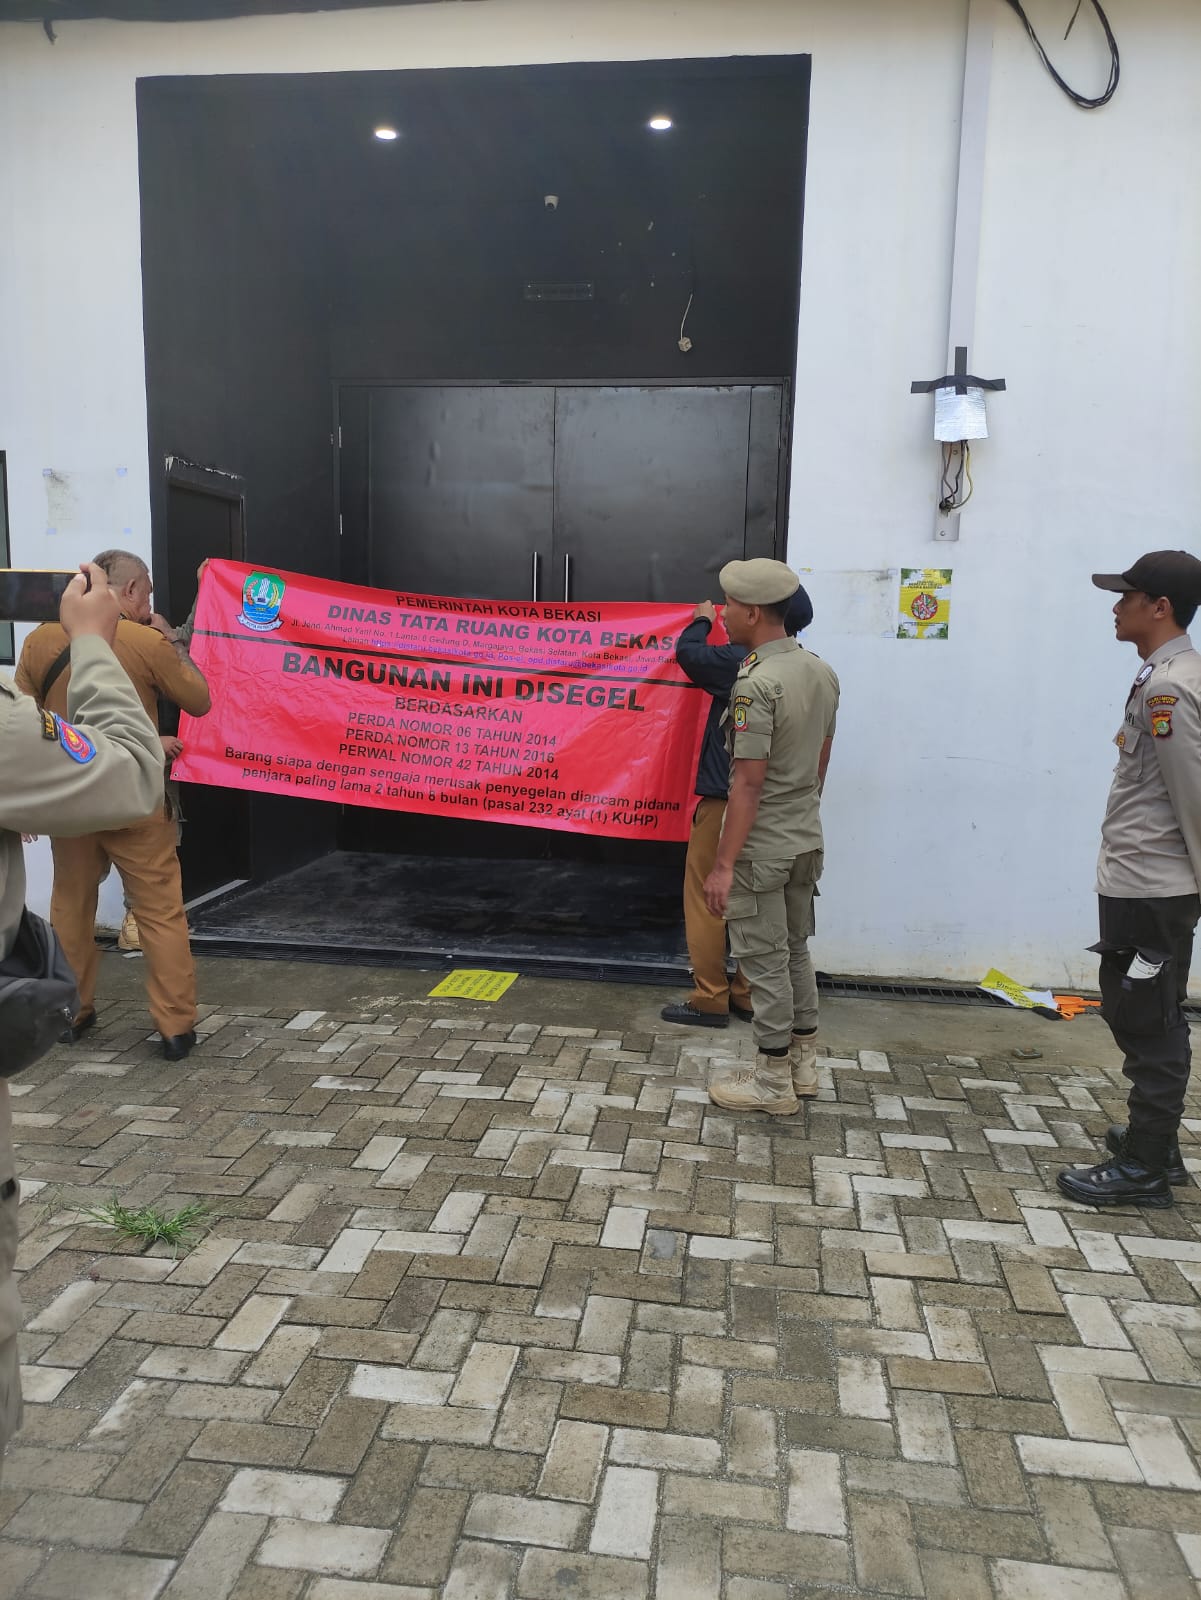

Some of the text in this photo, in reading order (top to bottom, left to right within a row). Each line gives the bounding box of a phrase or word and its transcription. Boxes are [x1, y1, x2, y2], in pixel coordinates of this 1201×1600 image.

[327, 605, 392, 625] DINAS
[400, 613, 448, 631] TATA
[456, 619, 529, 640] RUANG
[537, 627, 592, 645] KOTA
[396, 595, 600, 623] PEMERINTAH KOTA BEKASI
[324, 623, 353, 633] Ahmad
[581, 650, 601, 660] Kota
[658, 656, 678, 665] Bara
[282, 652, 645, 712] BANGUNAN INI DISEGEL
[395, 696, 523, 724] BERDASARKAN
[346, 728, 393, 744] PERDA
[397, 734, 450, 752] NOMOR
[455, 742, 469, 754] 13
[474, 743, 520, 759] TAHUN
[348, 712, 556, 747] PERDA NOMOR 06 TAHUN 2014
[225, 746, 681, 811] Barang siapa dengan sengaja merusak penyegelan diancam pidana
[339, 743, 559, 780] PERWAL NOMOR 42 TAHUN 2014
[242, 767, 291, 783] penjara
[295, 774, 336, 791] paling
[340, 778, 371, 793] lama
[375, 783, 383, 795] 2
[386, 785, 424, 800] tahun
[440, 791, 478, 807] bulan
[483, 796, 525, 811] (pasal
[529, 801, 554, 815] 232
[556, 807, 586, 820] ayat
[590, 810, 608, 824] (1)
[612, 811, 658, 829] KUHP)
